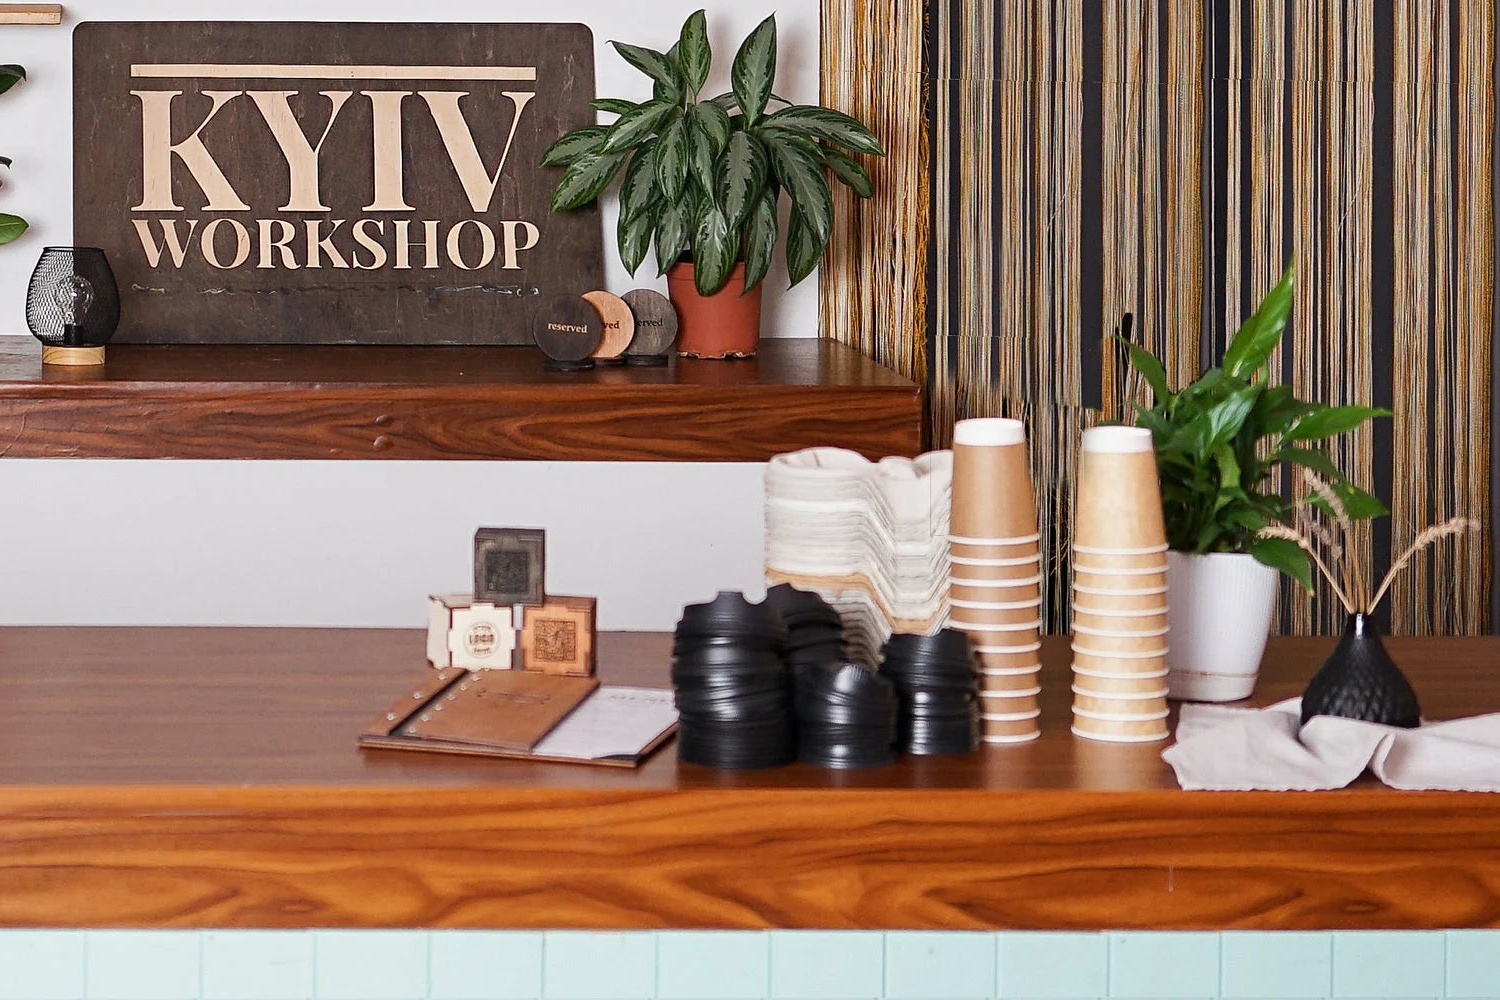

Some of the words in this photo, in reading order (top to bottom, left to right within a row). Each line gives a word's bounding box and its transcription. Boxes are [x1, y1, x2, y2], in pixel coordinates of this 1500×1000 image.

[130, 90, 536, 213] KYIV
[131, 218, 540, 270] WORKSHOP
[547, 322, 588, 334] reserved
[637, 319, 663, 327] erved
